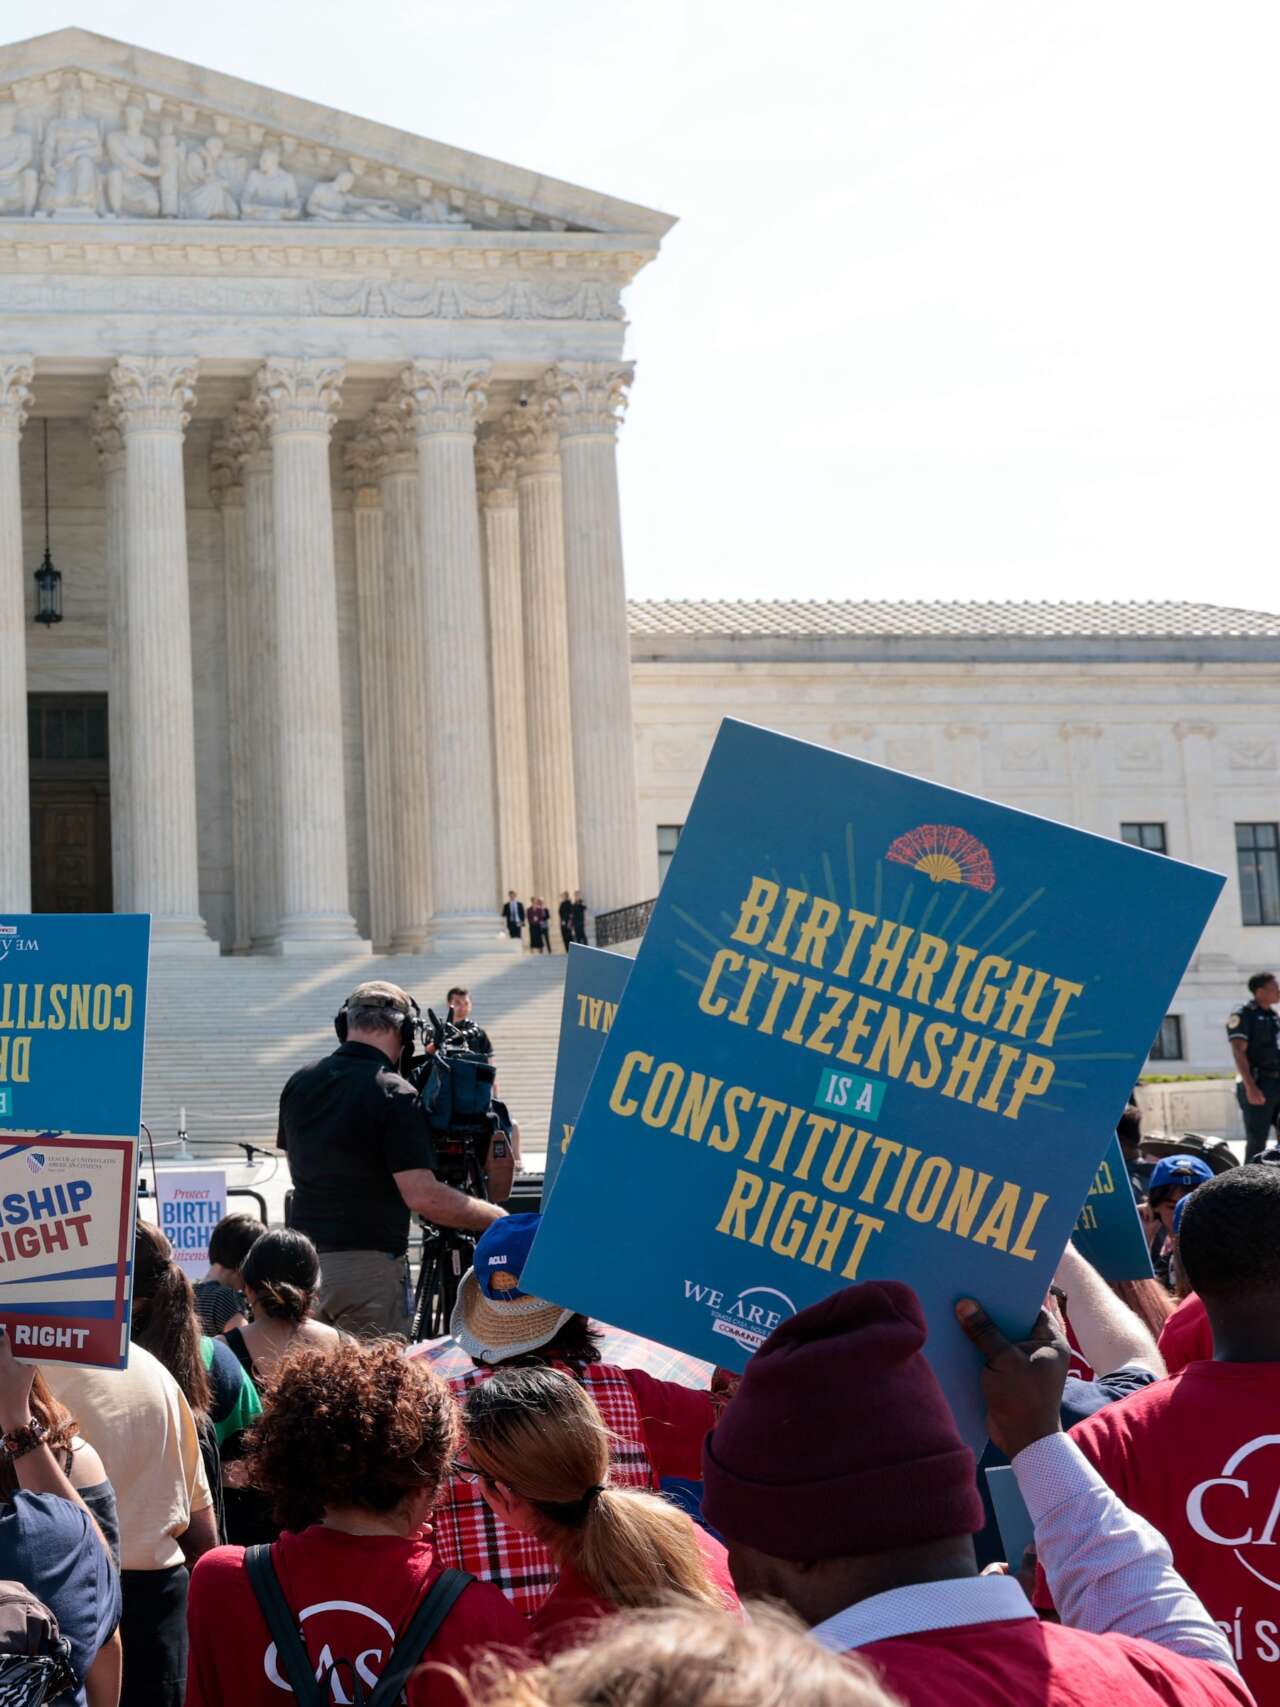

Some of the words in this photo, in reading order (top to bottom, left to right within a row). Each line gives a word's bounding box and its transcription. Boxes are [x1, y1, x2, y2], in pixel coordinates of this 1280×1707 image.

[16, 939, 39, 951] WE
[731, 876, 1083, 1047] BIRTHRIGHT
[698, 948, 1056, 1120] CITIZENSHIP
[824, 1075, 849, 1108] IS
[855, 1085, 874, 1113] A
[609, 1050, 1049, 1261] CONSTITUTIONAL
[174, 1189, 210, 1199] Protect
[163, 1201, 221, 1224] BIRTH
[716, 1170, 884, 1280] RIGHT
[164, 1226, 216, 1249] RIGH
[487, 1255, 508, 1265] ACLU
[684, 1279, 725, 1310] WE
[726, 1300, 782, 1330] ARE
[16, 1325, 90, 1349] RIGHT
